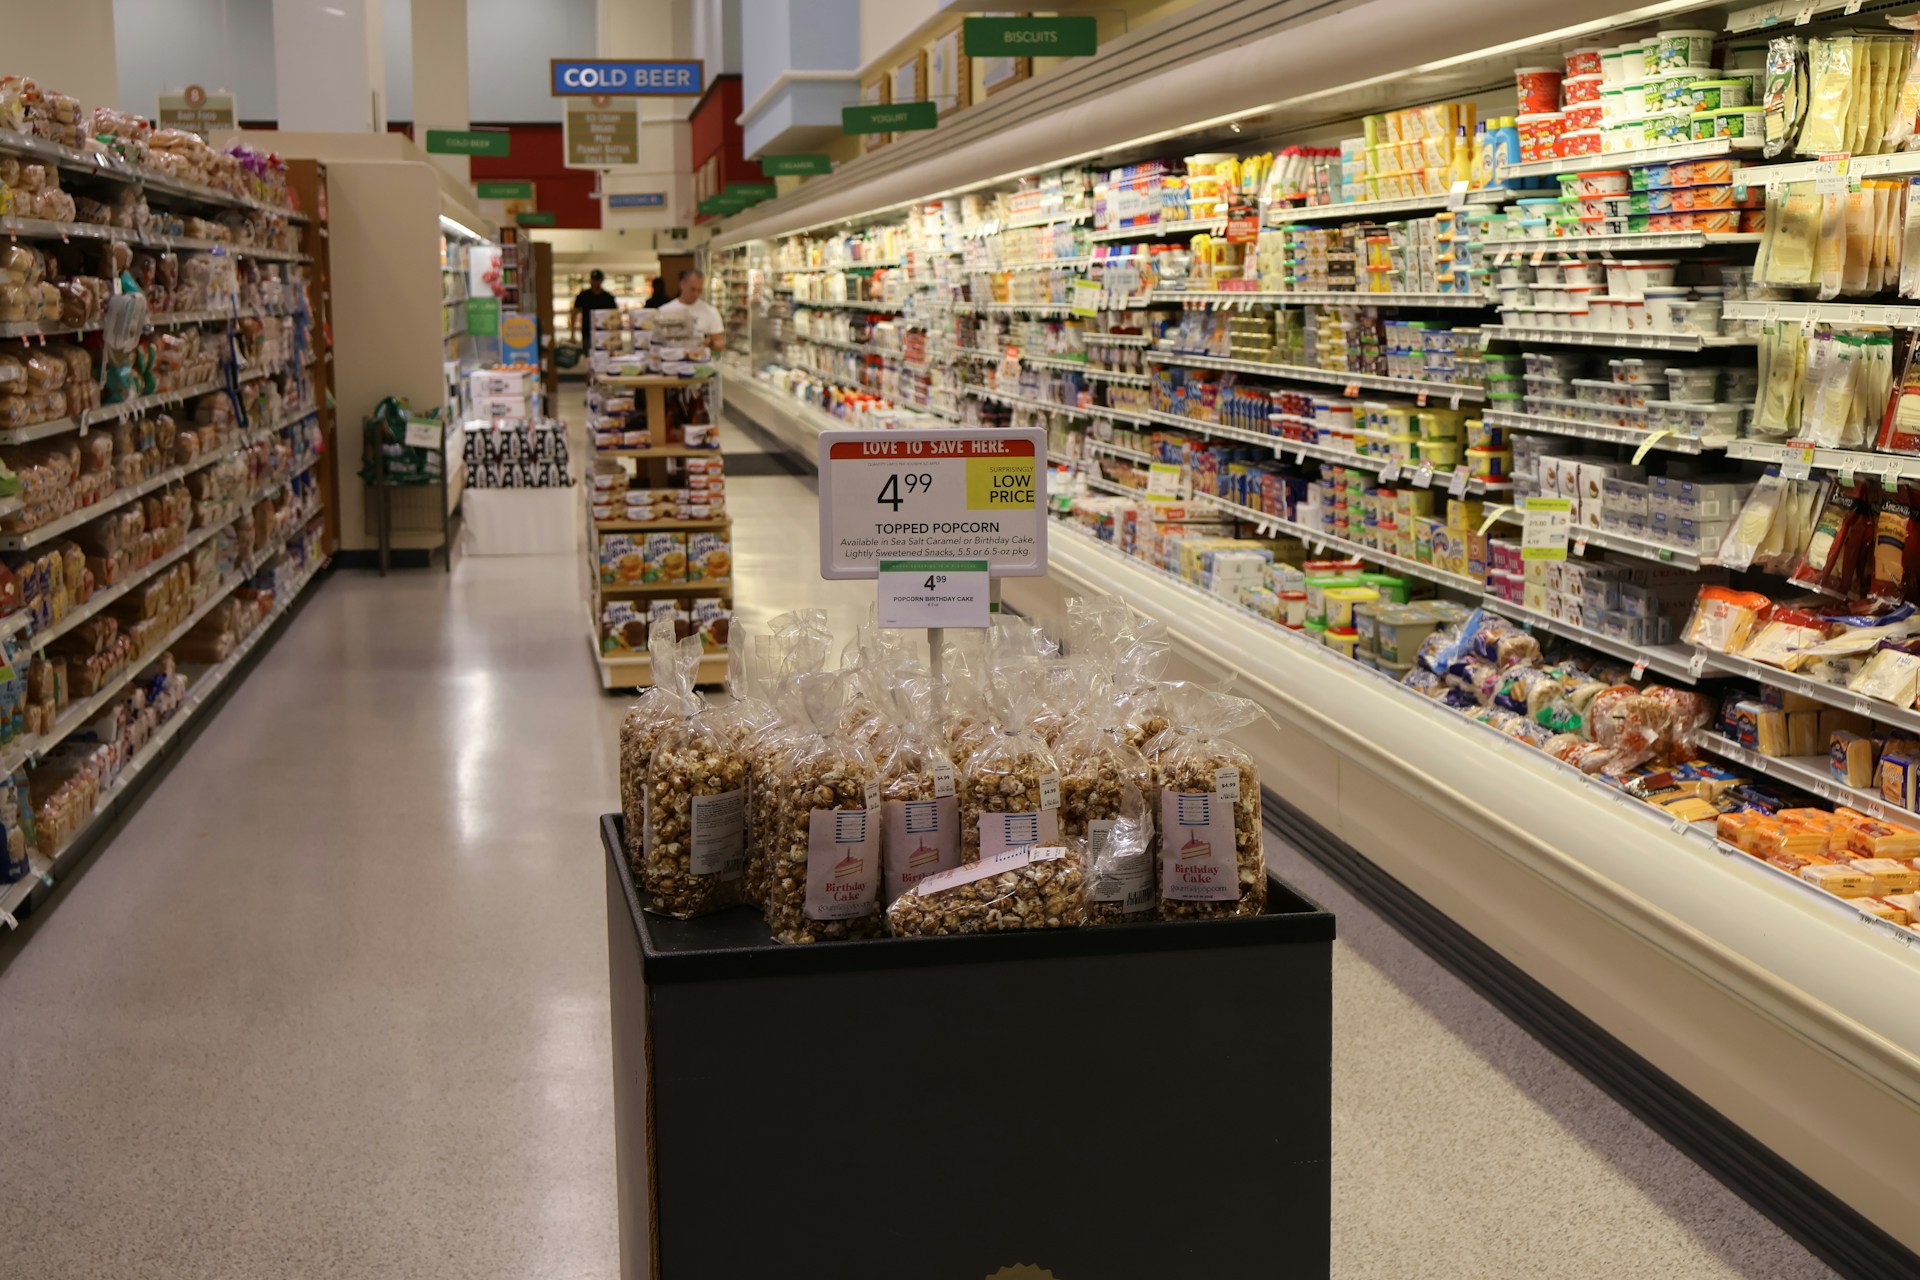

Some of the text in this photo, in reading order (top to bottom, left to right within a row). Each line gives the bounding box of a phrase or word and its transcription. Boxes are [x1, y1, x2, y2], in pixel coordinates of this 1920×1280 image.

[1004, 31, 1058, 43] BISCUITS
[564, 67, 691, 88] COLD BEER
[871, 112, 908, 124] YOGURT
[446, 138, 490, 147] COLD BEER
[863, 440, 1010, 455] LOVE TO SAVE HERE.
[993, 475, 1031, 488] LOW
[990, 490, 1035, 503] PRICE
[875, 522, 1000, 534] TOPPED POPCORN
[840, 538, 879, 546] Available
[908, 537, 924, 545] Salt
[926, 537, 962, 545] Caramel
[975, 536, 1010, 546] Birthday
[1012, 536, 1035, 545] Cake,
[845, 549, 873, 559] Lightly
[875, 549, 922, 557] Sweetened
[924, 549, 955, 558] Snacks,
[957, 548, 971, 556] 5.5
[983, 548, 1010, 556] 6.5-oz
[1012, 547, 1031, 557] pkg.
[1175, 863, 1219, 876] Birthday
[1183, 874, 1211, 883] Cake
[826, 882, 865, 893] Birthday
[834, 891, 860, 902] Cake
